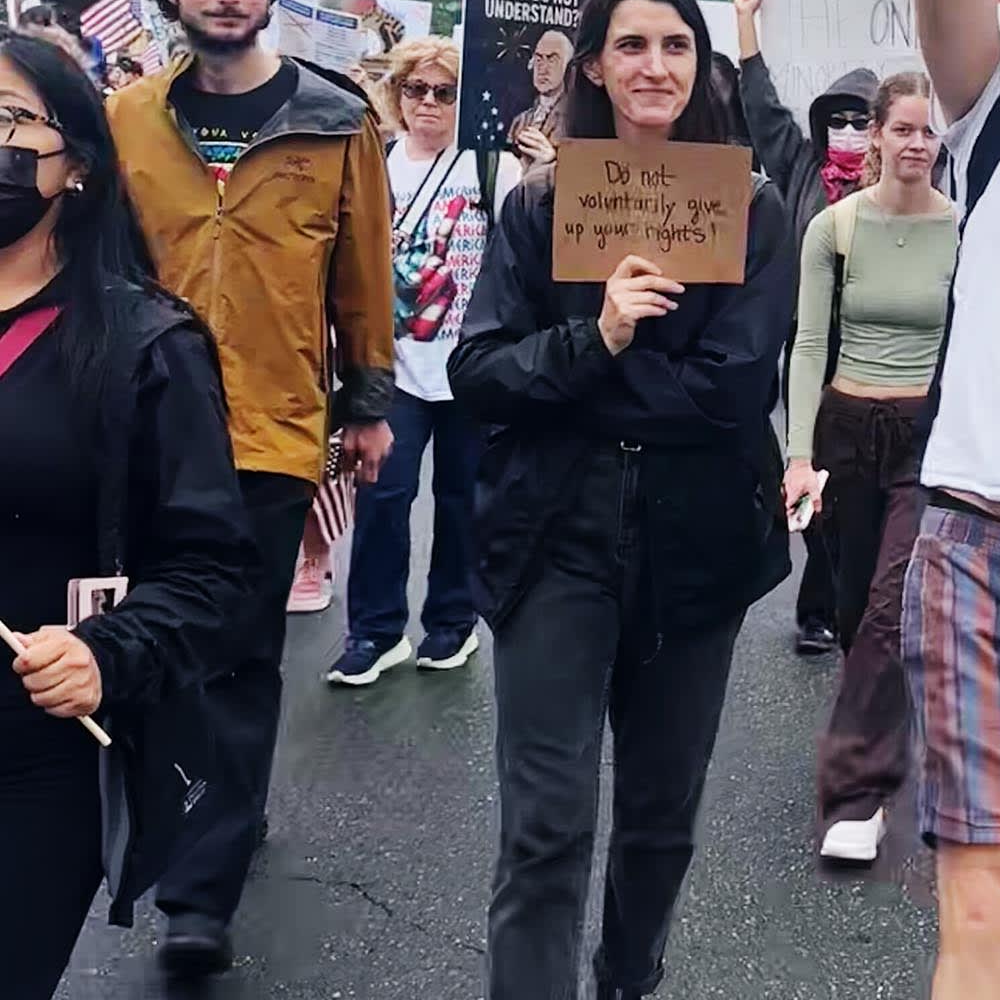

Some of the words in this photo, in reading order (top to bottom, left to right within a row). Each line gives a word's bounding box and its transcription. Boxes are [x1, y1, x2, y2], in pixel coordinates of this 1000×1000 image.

[604, 160, 631, 185] Do
[641, 164, 678, 188] not
[579, 191, 677, 227] voluntarily
[687, 199, 727, 225] give
[565, 221, 585, 245] up
[593, 221, 630, 250] your
